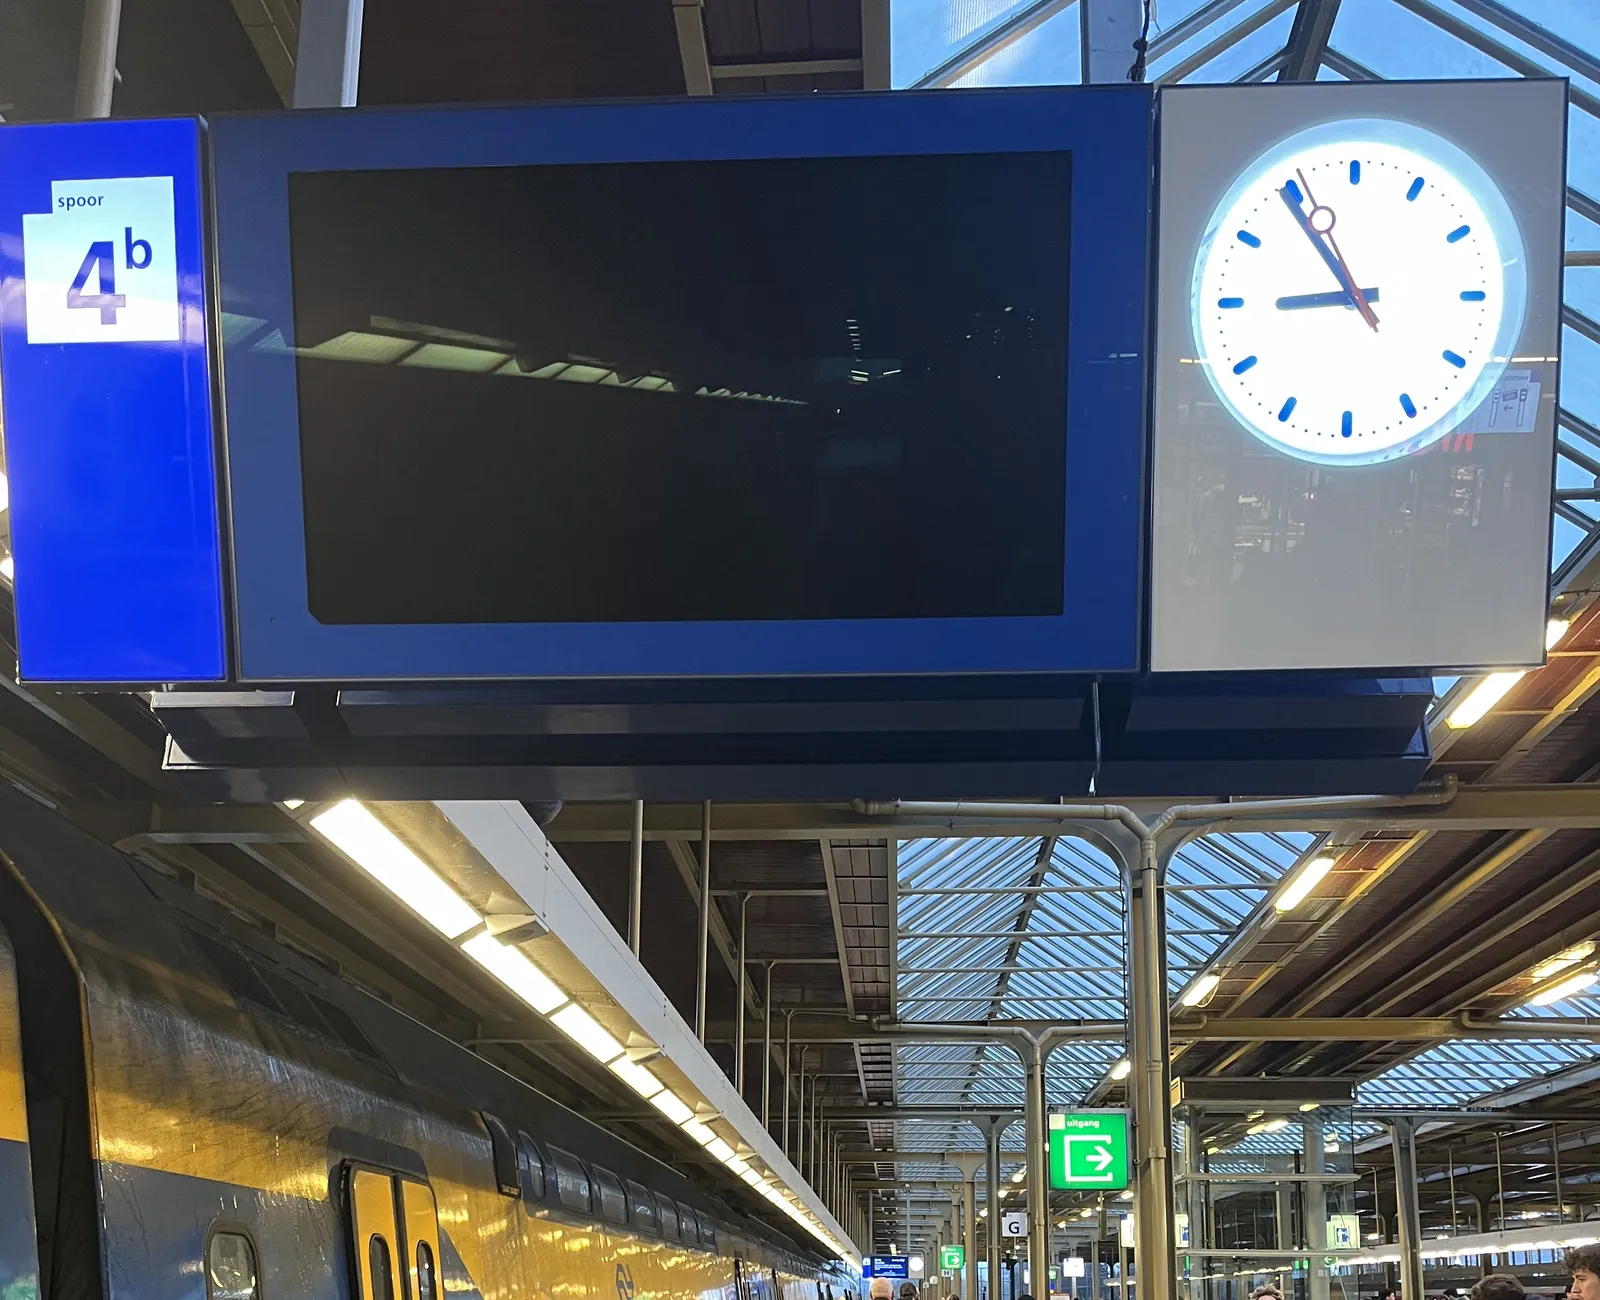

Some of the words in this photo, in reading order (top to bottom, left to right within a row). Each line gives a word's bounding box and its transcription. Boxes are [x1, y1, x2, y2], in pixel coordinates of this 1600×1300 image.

[58, 195, 104, 210] spoor
[1067, 1118, 1100, 1128] uitgang
[1008, 1221, 1020, 1234] G
